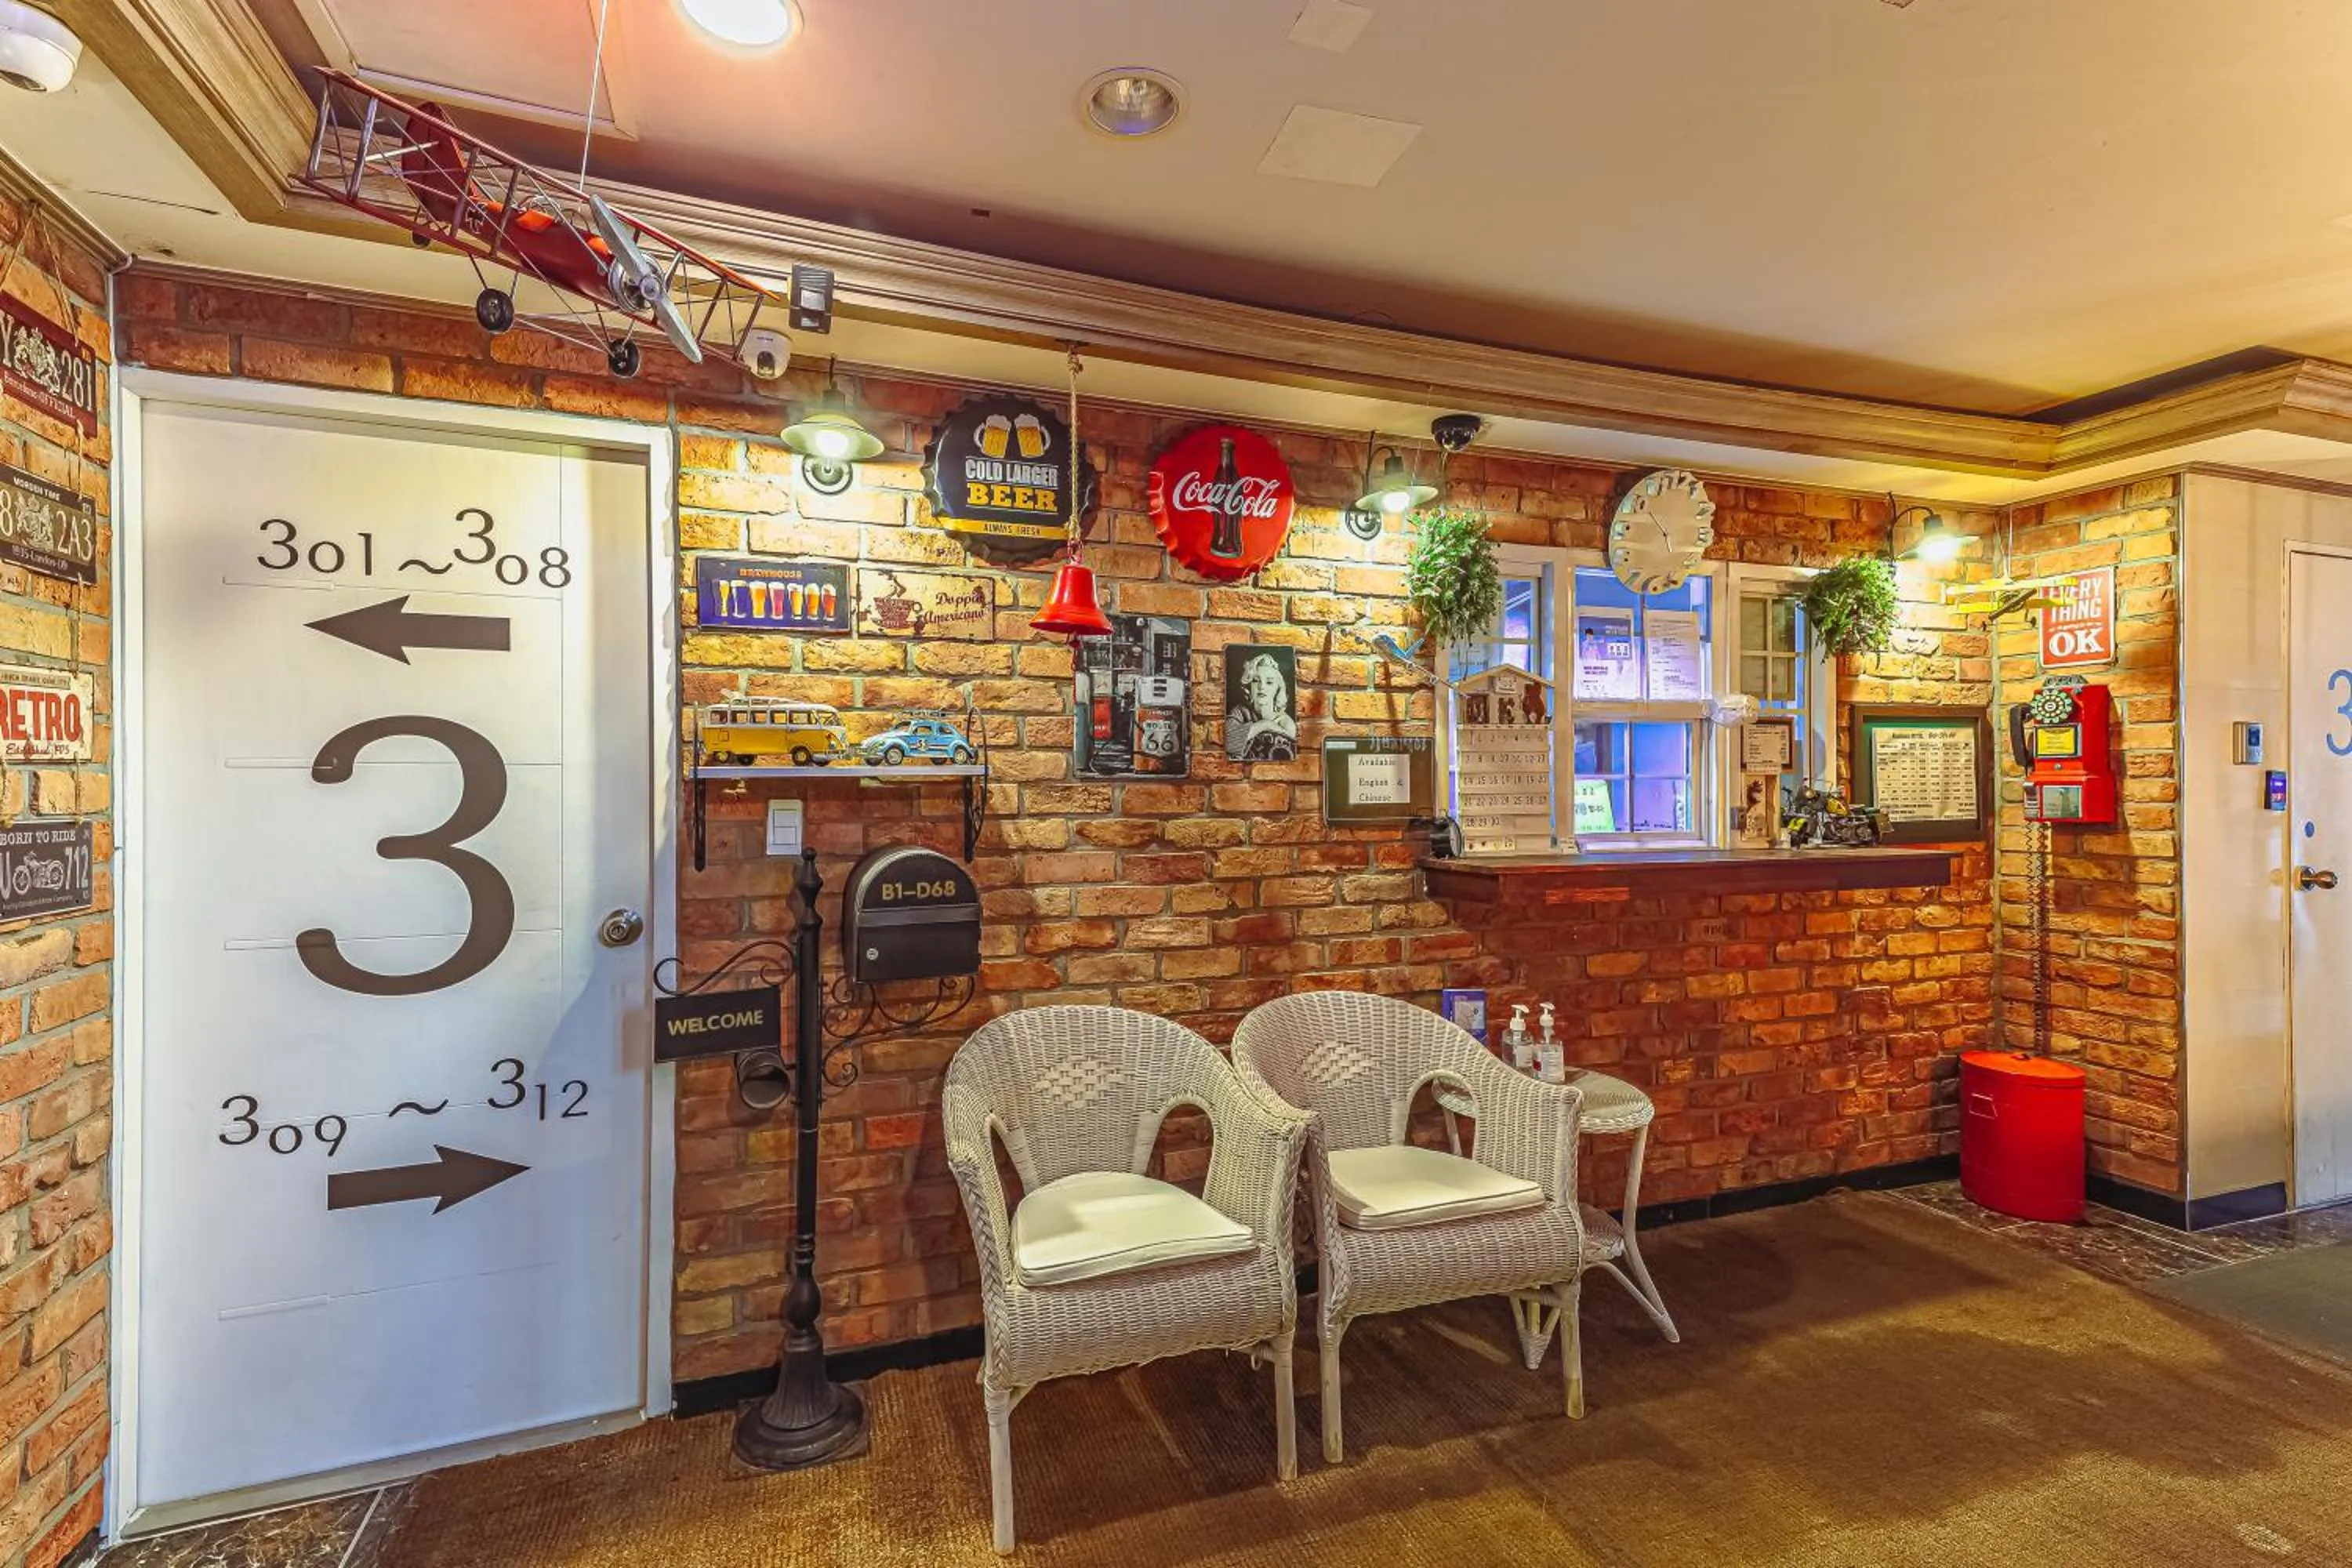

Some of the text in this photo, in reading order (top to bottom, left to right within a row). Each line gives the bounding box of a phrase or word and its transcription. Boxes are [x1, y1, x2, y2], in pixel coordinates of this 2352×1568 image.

[60, 350, 93, 412] 281
[965, 458, 1058, 487] COLD LARGER
[967, 481, 1058, 512] BEER
[1172, 470, 1280, 519] Coca-Cola
[56, 510, 93, 561] 2A3
[982, 522, 1041, 536] ALWAYS FRESH
[256, 517, 374, 575] 301
[452, 508, 572, 589] 308
[2049, 626, 2105, 657] OK
[1147, 732, 1174, 752] 66
[35, 831, 49, 844] TO
[51, 829, 76, 843] RIDE
[64, 845, 89, 890] 712
[295, 713, 515, 996] 3
[882, 880, 956, 901] B1-D68
[667, 1009, 764, 1036] WELCOME
[218, 1094, 348, 1157] 309
[486, 1058, 590, 1121] 312
